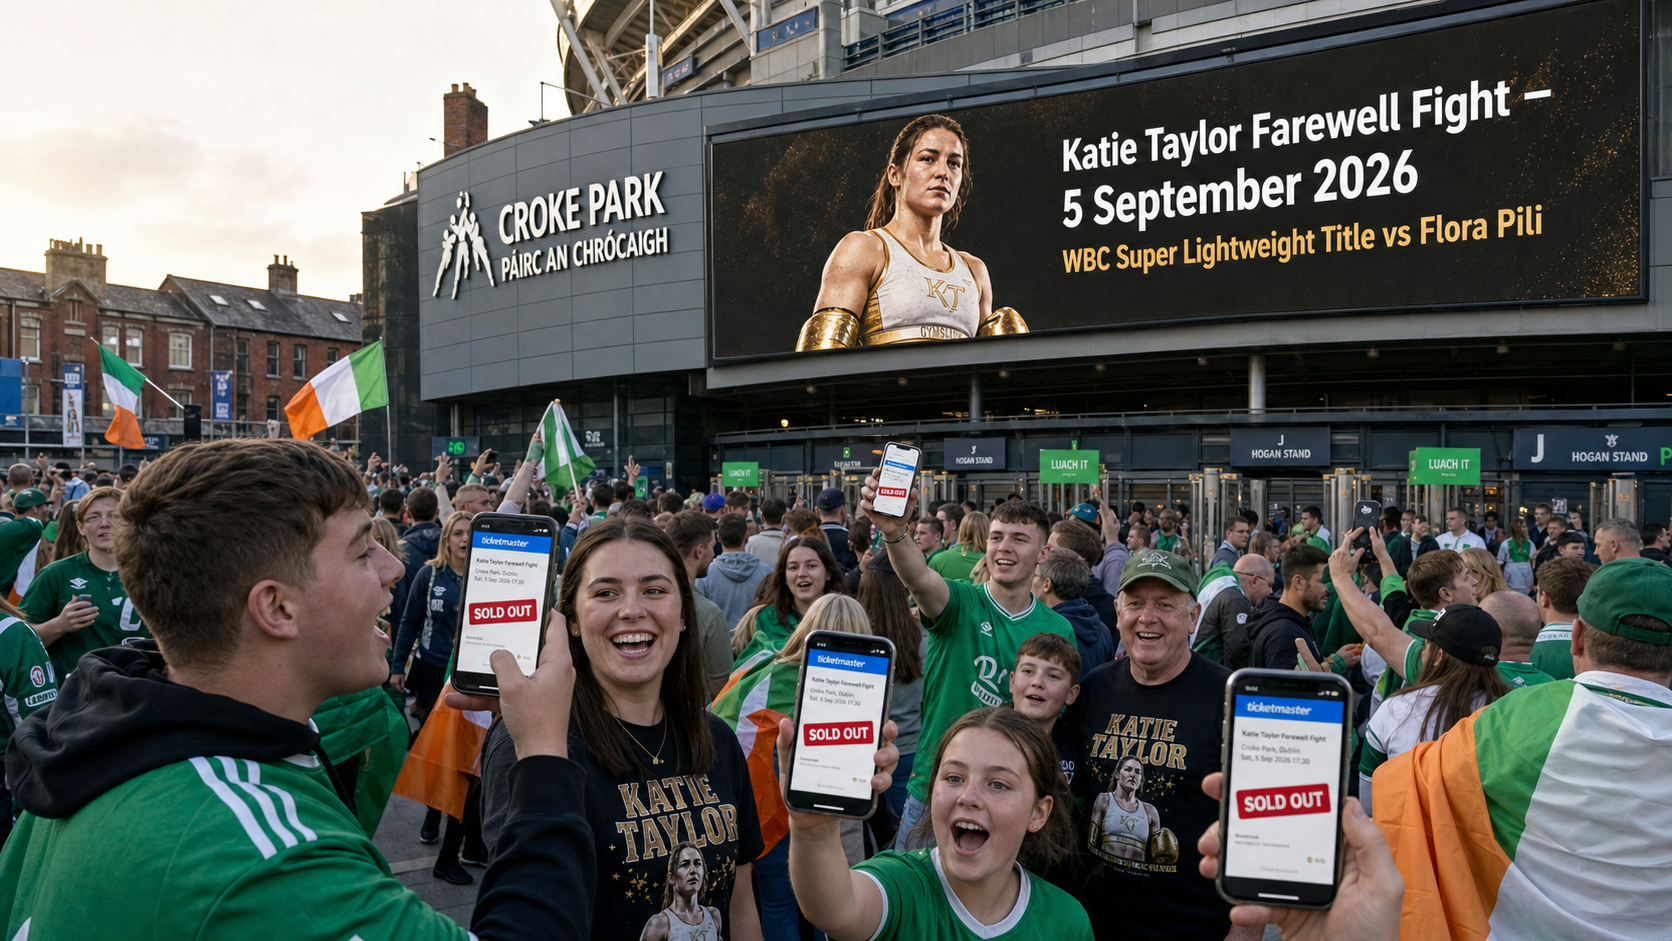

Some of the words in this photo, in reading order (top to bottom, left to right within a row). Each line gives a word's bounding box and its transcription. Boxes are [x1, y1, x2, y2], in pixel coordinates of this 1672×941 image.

[1063, 132, 1137, 172] Katie
[1145, 119, 1242, 166] Taylor
[1253, 92, 1400, 148] Farewell
[1412, 80, 1510, 134] Fight
[1062, 188, 1083, 228] 5
[1093, 168, 1302, 232] September
[1314, 149, 1418, 202] 2026
[499, 187, 581, 244] CROKE
[589, 171, 666, 226] PARK
[1062, 246, 1110, 273] WBC
[1116, 244, 1178, 274] Super
[1184, 228, 1315, 269] Lightweight
[1321, 222, 1375, 252] Title
[1382, 225, 1411, 248] vs
[1420, 214, 1487, 244] Flora
[1498, 204, 1542, 238] Pili
[502, 249, 542, 282] PÁIRC
[546, 244, 568, 273] AN
[574, 227, 668, 267] CHRÓCAIGH
[924, 277, 965, 312] KT
[1278, 434, 1284, 446] J
[1531, 434, 1544, 463] J
[1252, 449, 1281, 459] HOGAN
[1284, 449, 1311, 458] STAND
[1572, 452, 1609, 462] HOGAN
[1612, 452, 1648, 462] STAND
[1051, 460, 1078, 469] LUACH
[1081, 460, 1089, 469] IT
[1429, 459, 1458, 469] LUACH
[1461, 459, 1470, 469] IT
[481, 536, 529, 547] ticketmaster
[474, 607, 504, 620] SOLD
[507, 605, 532, 618] OUT
[1247, 702, 1312, 715] ticketmaster
[809, 728, 840, 741] SOLD
[843, 727, 869, 739] OUT
[1105, 714, 1178, 742] KATIE
[1261, 731, 1280, 739] Taylor
[1281, 732, 1308, 740] Farewell
[1310, 734, 1327, 743] Fight
[1090, 734, 1187, 770] TAYLOR
[1279, 746, 1300, 754] Dublin
[1260, 755, 1273, 763] Sep
[1274, 756, 1291, 764] 2026
[618, 774, 720, 818] KATIE
[1244, 794, 1286, 813] SOLD
[1290, 791, 1324, 809] OUT
[616, 804, 739, 863] TAYLOR
